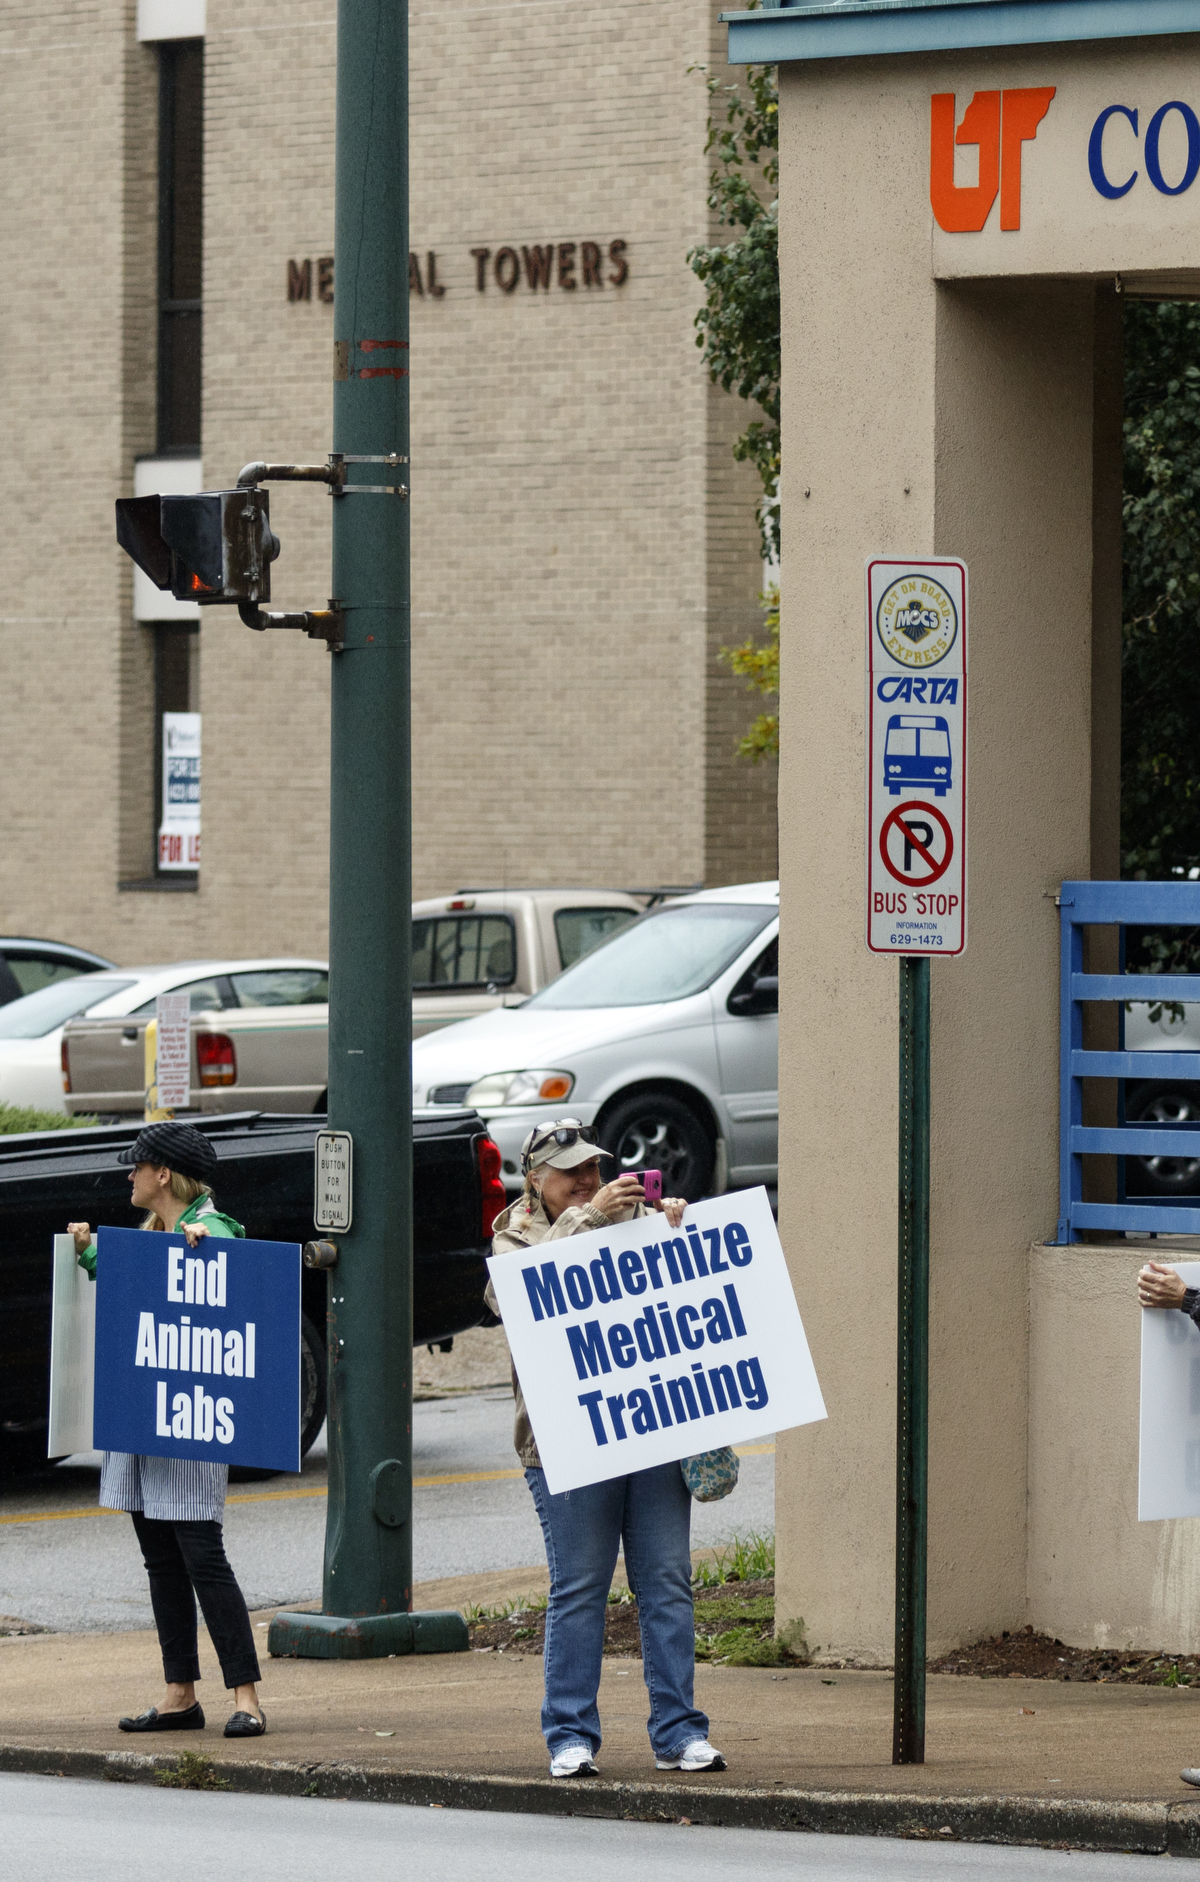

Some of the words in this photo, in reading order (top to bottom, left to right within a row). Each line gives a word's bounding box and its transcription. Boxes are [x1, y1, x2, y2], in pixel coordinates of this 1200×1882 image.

[286, 251, 445, 304] MEAL
[469, 239, 630, 293] TOWERS
[884, 591, 899, 616] GET
[901, 581, 917, 596] ON
[920, 582, 950, 618] BOARD
[896, 609, 939, 630] MOCS
[887, 636, 948, 664] EXPRESS
[877, 676, 959, 705] CARTA
[160, 834, 183, 862] FOR
[874, 892, 907, 914] BUS
[917, 894, 959, 915] STOP
[896, 921, 937, 930] INFORMATION
[890, 934, 943, 946] 629-1473
[325, 1143, 342, 1153] PUSH
[321, 1159, 345, 1170] BUTTON
[327, 1176, 339, 1187] FOR
[325, 1193, 341, 1204] WALK
[322, 1210, 344, 1221] SIGNAL
[168, 1248, 227, 1307] End
[522, 1222, 753, 1322] Modernize
[136, 1312, 255, 1378] Animal
[566, 1284, 748, 1381] Medical
[156, 1382, 235, 1444] Labs
[578, 1356, 769, 1447] Training
